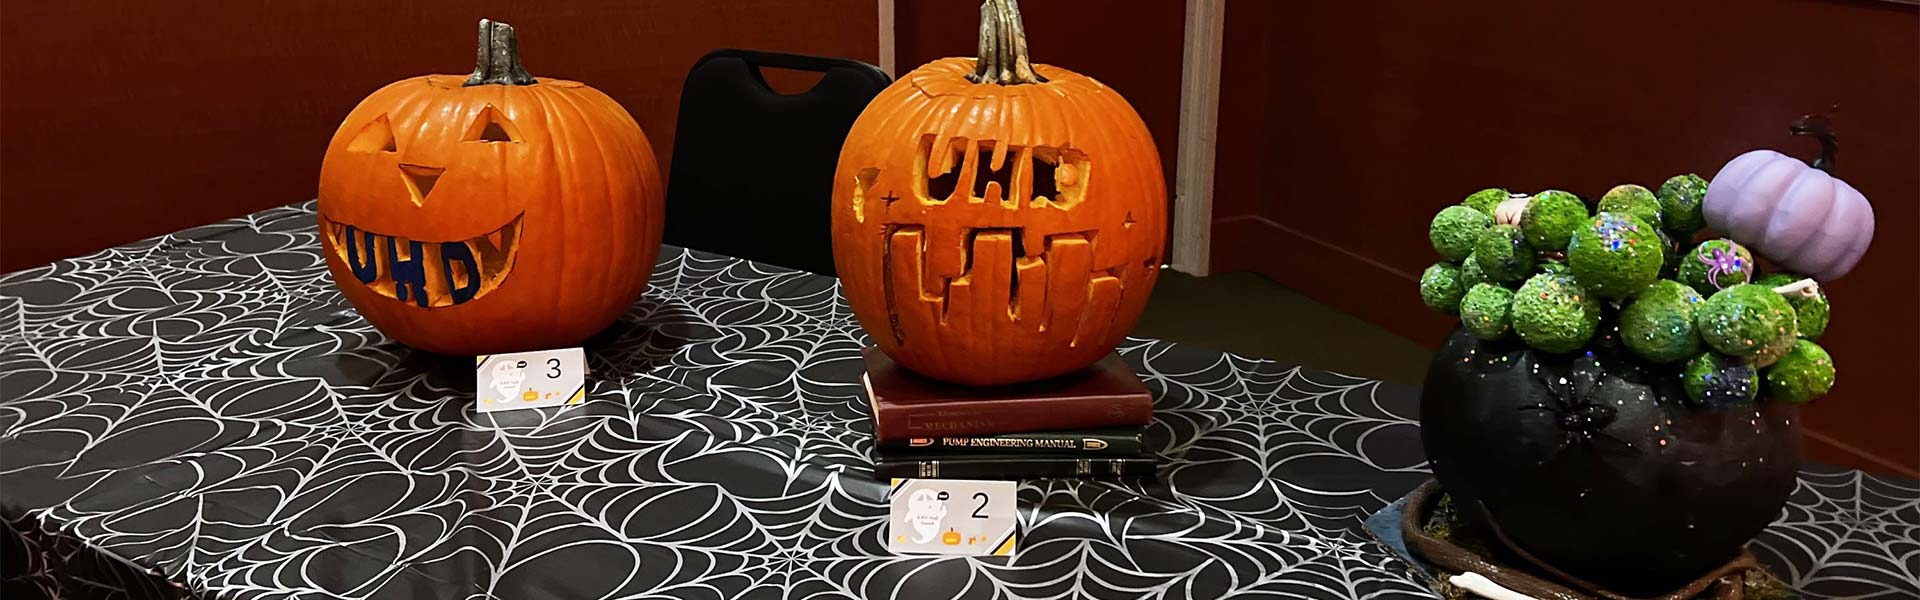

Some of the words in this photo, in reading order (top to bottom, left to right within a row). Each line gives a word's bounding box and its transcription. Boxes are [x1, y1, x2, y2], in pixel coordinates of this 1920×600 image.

[346, 225, 480, 307] UHD
[546, 358, 562, 379] 3
[943, 437, 969, 446] PUMP
[970, 438, 1034, 448] ENGINEERING
[1035, 439, 1077, 449] MANUAL
[971, 492, 990, 519] 2
